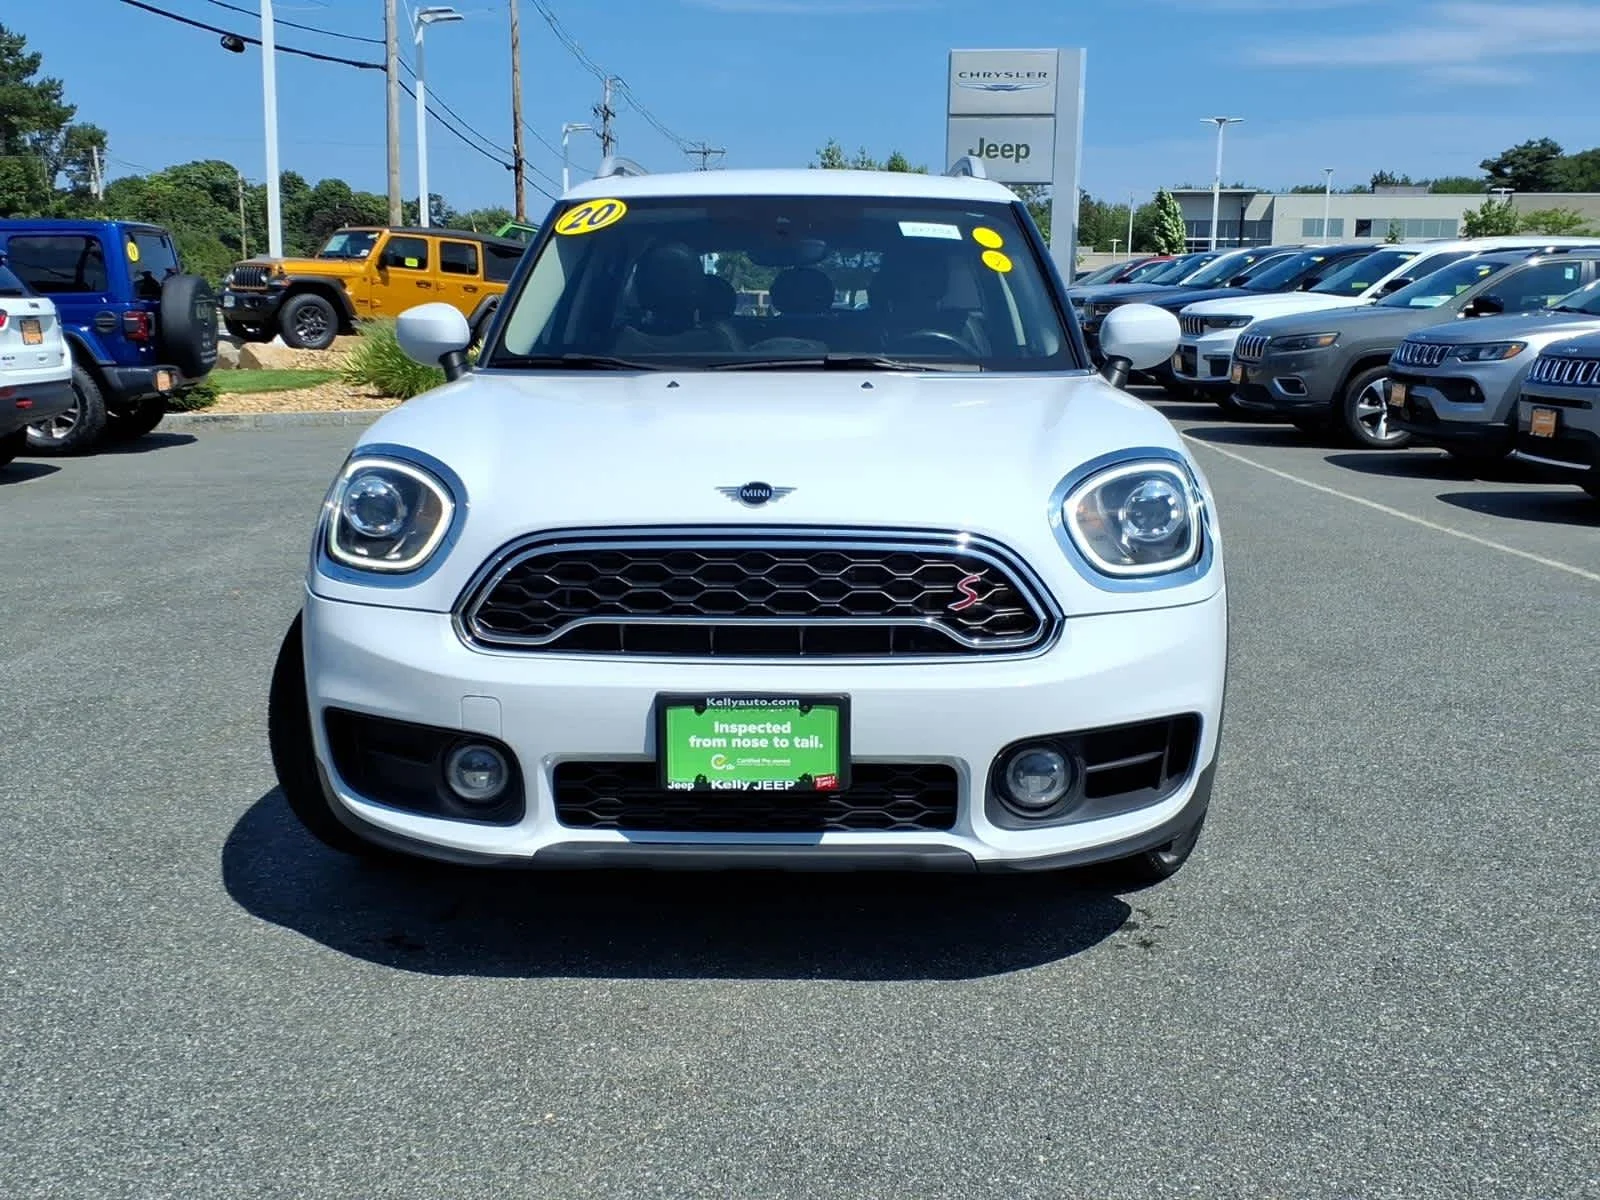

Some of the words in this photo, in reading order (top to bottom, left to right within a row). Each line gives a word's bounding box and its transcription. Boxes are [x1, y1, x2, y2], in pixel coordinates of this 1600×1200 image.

[958, 71, 1048, 79] CHRYSLER
[968, 137, 1030, 163] Jeep
[563, 203, 616, 231] 20
[742, 489, 770, 497] MINI
[947, 574, 981, 612] S
[706, 697, 800, 707] Kellyauto.com
[714, 720, 792, 736] Inspected
[689, 735, 727, 748] from
[731, 737, 769, 748] nose
[773, 736, 790, 748] to
[794, 734, 824, 748] tail.
[667, 781, 695, 791] Jeep
[711, 779, 750, 791] Kelly
[753, 780, 795, 791] JEEP
